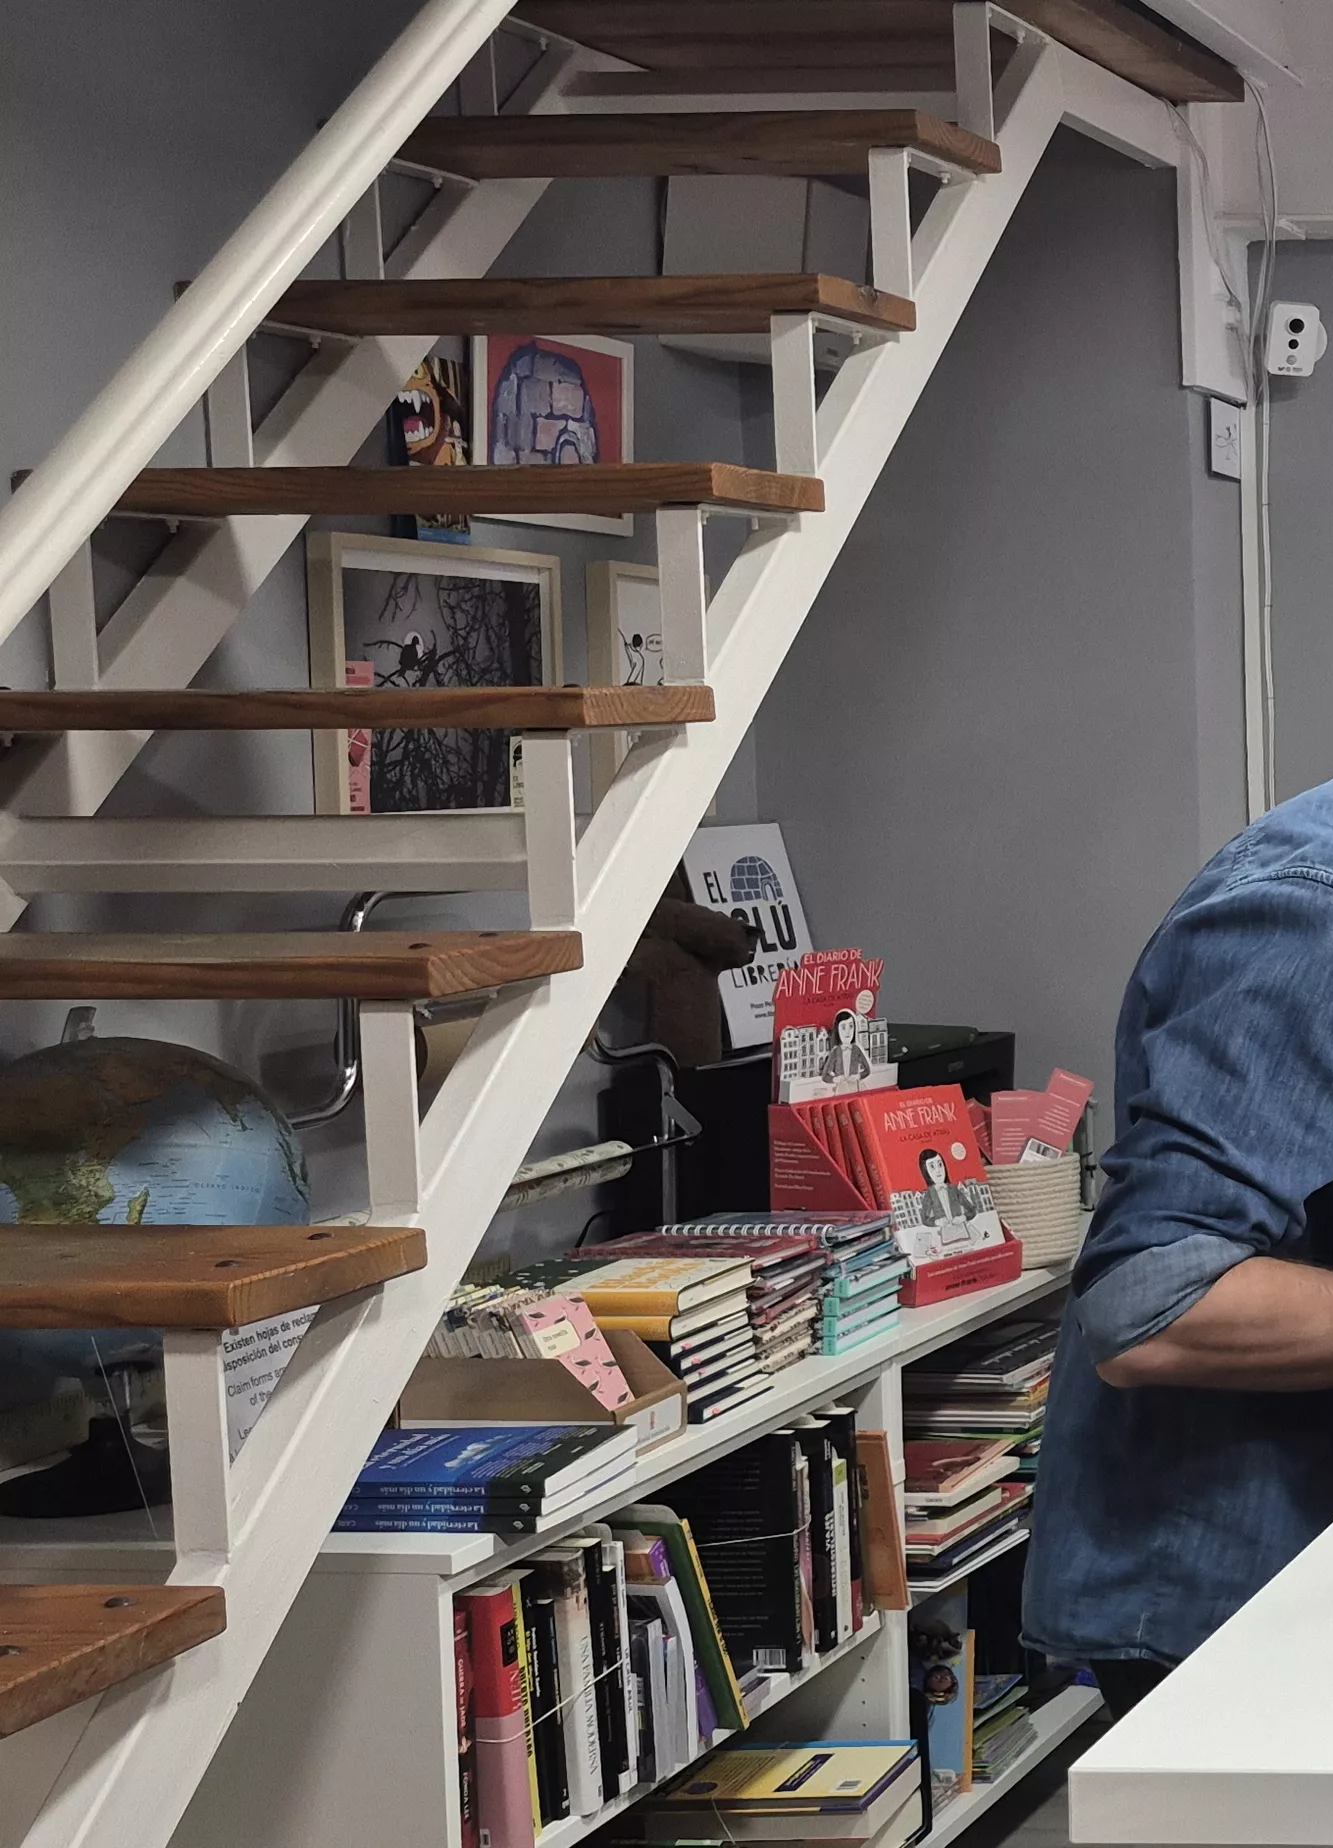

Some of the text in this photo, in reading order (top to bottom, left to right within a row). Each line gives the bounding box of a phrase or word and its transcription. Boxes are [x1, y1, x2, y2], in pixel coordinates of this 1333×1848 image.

[703, 870, 728, 904] EL
[803, 949, 863, 965] EL DIARIO DE
[776, 959, 885, 999] ANNE FRANK
[882, 1101, 957, 1132] ANNE FRANK
[223, 1333, 255, 1354] Existen
[256, 1326, 279, 1344] hojas
[279, 1320, 291, 1333] de
[267, 1340, 282, 1355] del
[227, 1379, 251, 1398] Claim
[250, 1371, 273, 1390] forms
[249, 1394, 258, 1406] of
[374, 1520, 393, 1530] más
[394, 1520, 408, 1530] día
[470, 1521, 479, 1531] La
[579, 1635, 590, 1663] UNA
[585, 1714, 599, 1776] MODERNA
